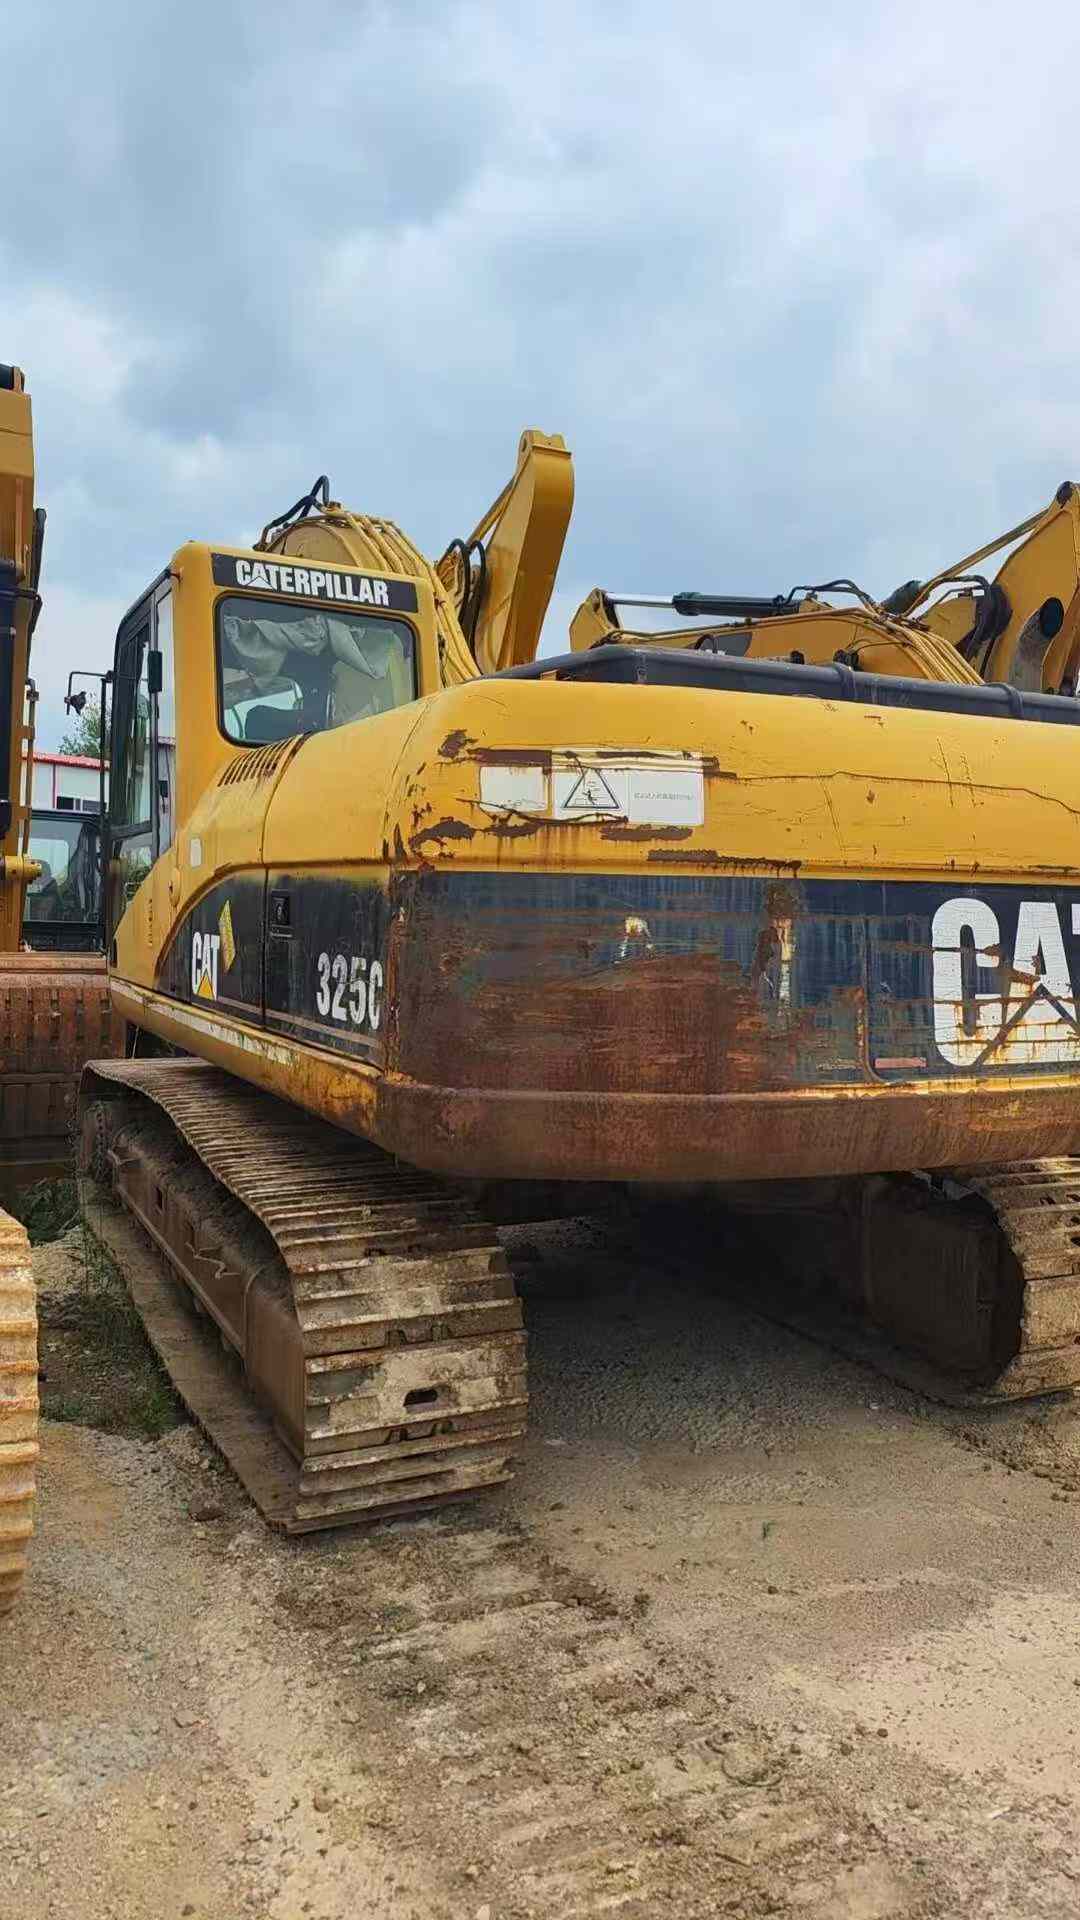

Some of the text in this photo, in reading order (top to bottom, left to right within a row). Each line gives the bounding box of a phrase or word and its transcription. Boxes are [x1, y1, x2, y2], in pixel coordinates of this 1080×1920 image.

[235, 560, 390, 606] CATERPILLAR
[192, 931, 220, 1002] CAT
[316, 952, 383, 1029] 325C
[931, 897, 1080, 1066] CA
